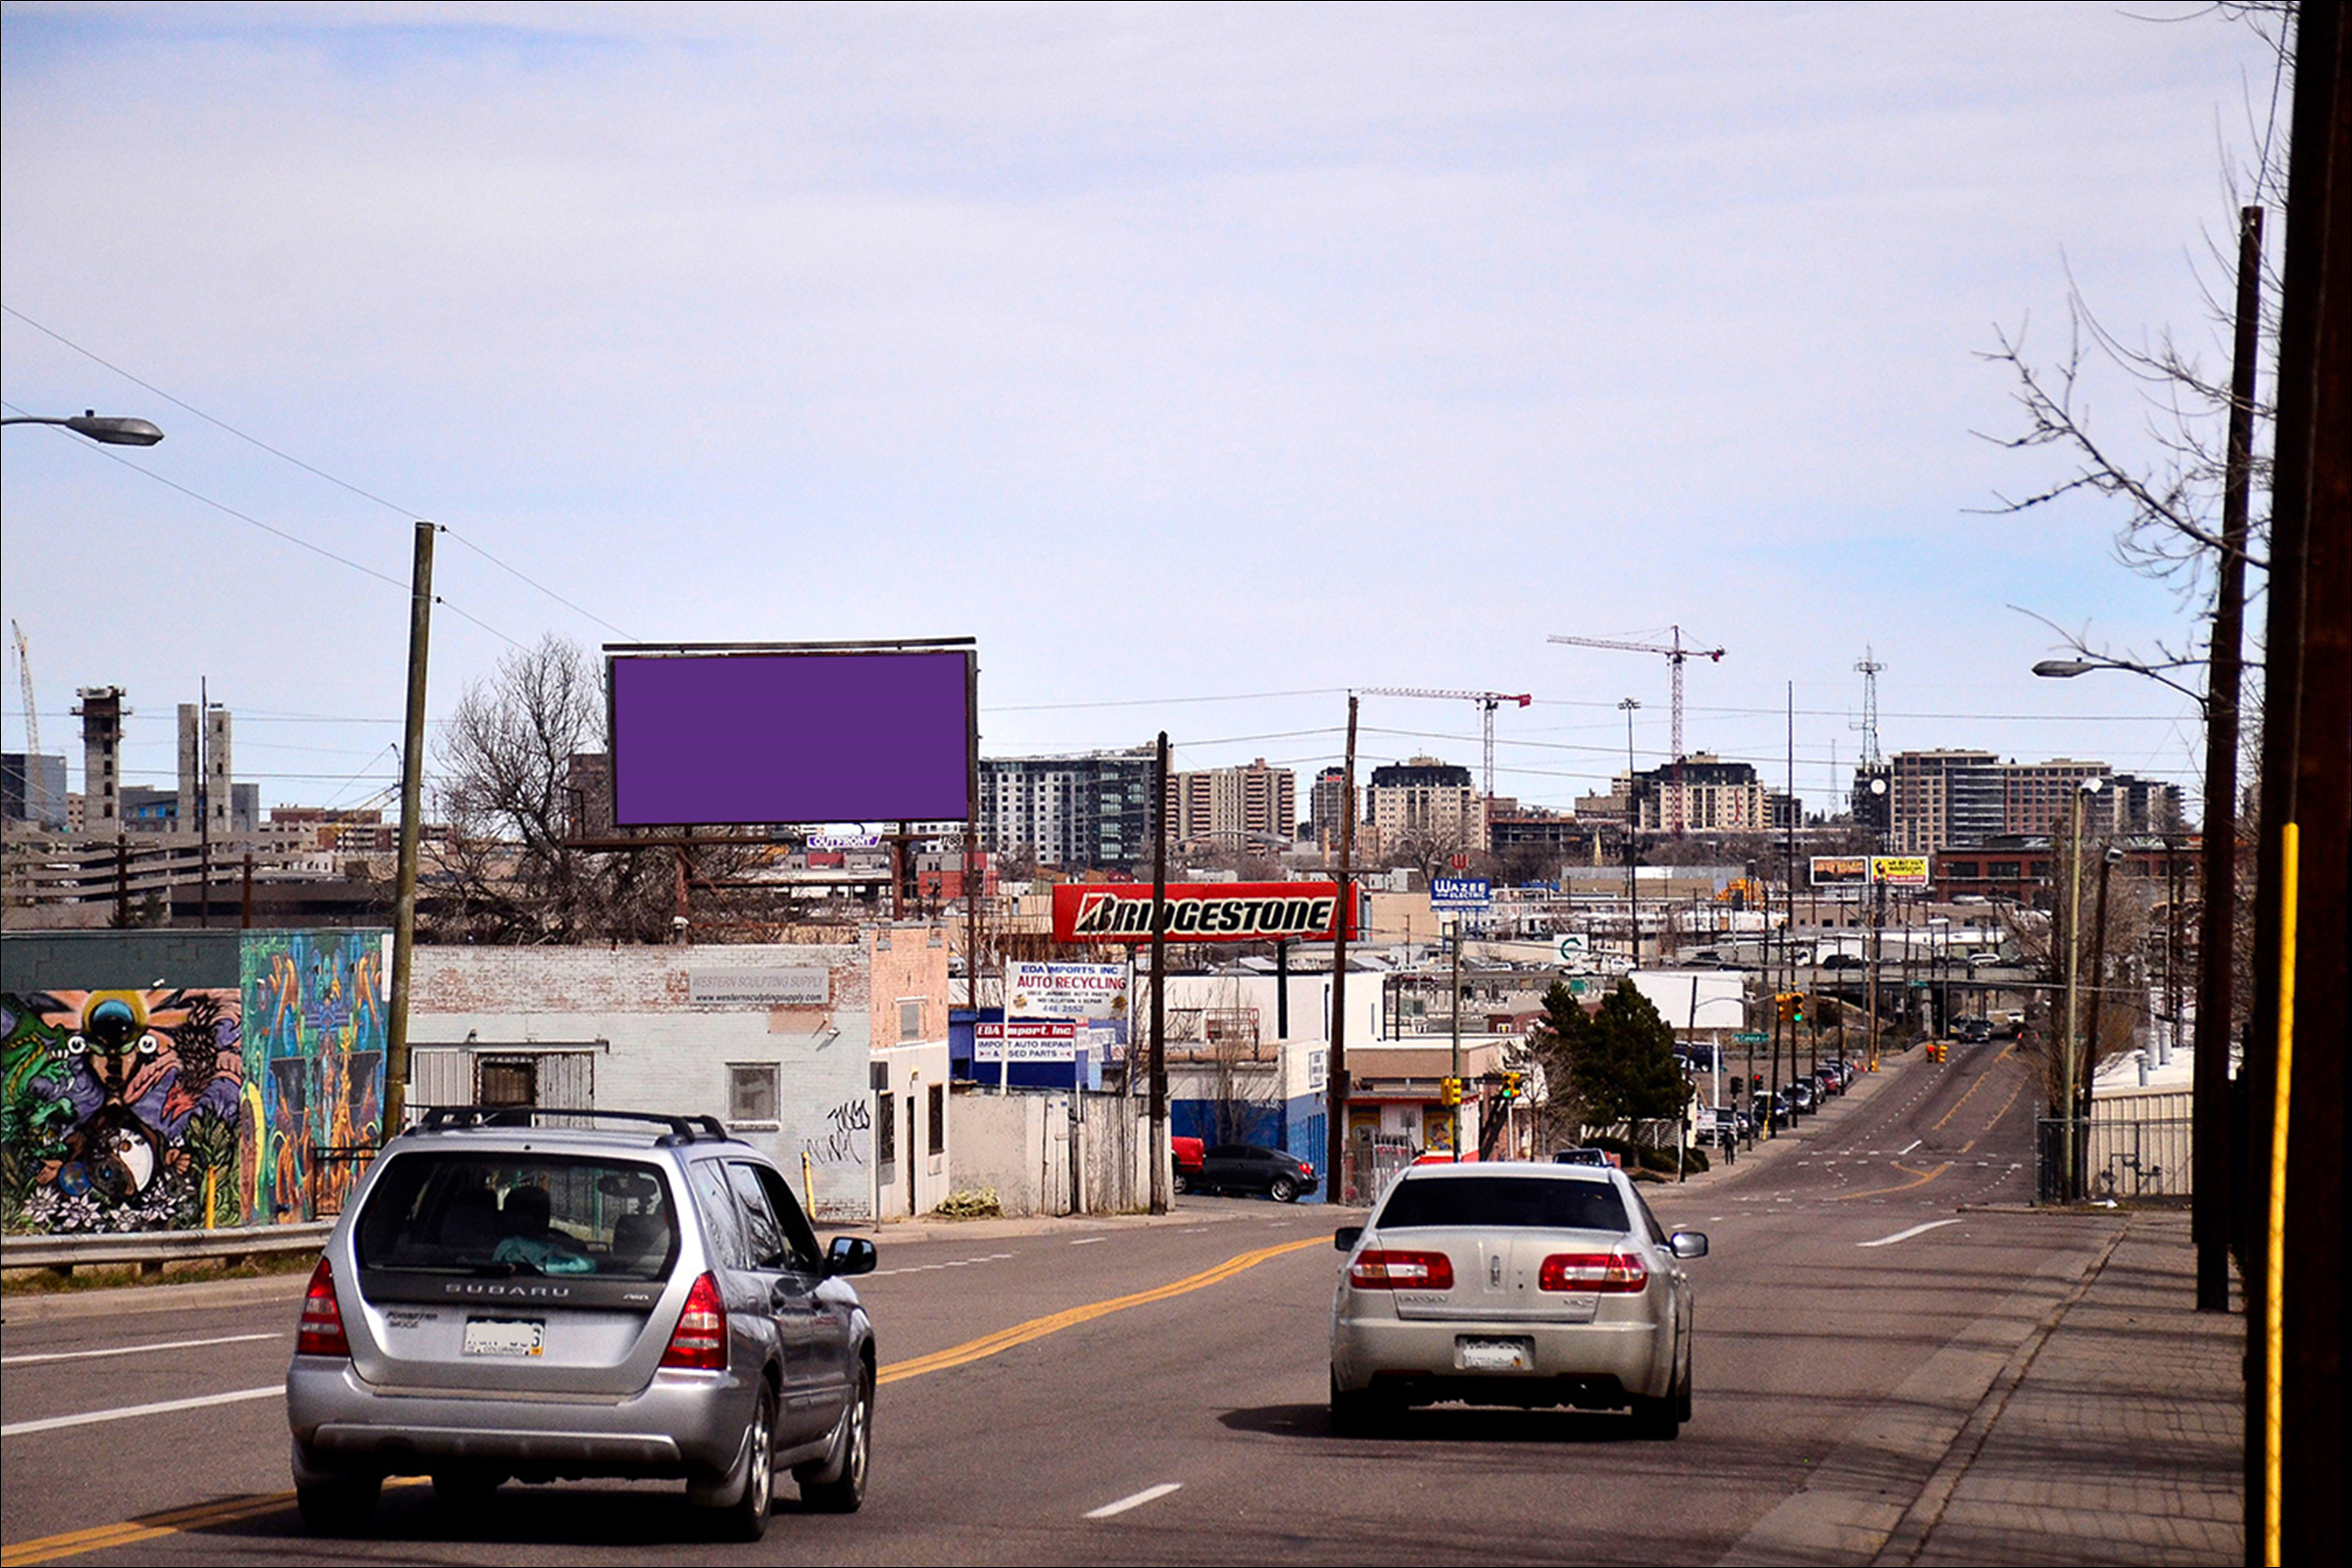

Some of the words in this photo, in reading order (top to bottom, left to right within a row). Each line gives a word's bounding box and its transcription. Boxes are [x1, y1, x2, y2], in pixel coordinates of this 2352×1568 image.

[813, 835, 872, 847] OUTFRONT
[1434, 879, 1486, 893] WAZEE
[1073, 891, 1337, 935] BRIDGESTONE
[1021, 965, 1046, 974] EDA
[1048, 966, 1096, 975] IMPORTS
[1100, 966, 1119, 975] INC
[693, 976, 735, 988] WESTERN
[790, 976, 825, 988] SUPPLY
[1017, 975, 1053, 989] AUTO
[1054, 976, 1127, 991] RECYCLING
[445, 1284, 569, 1298] SUBARU
